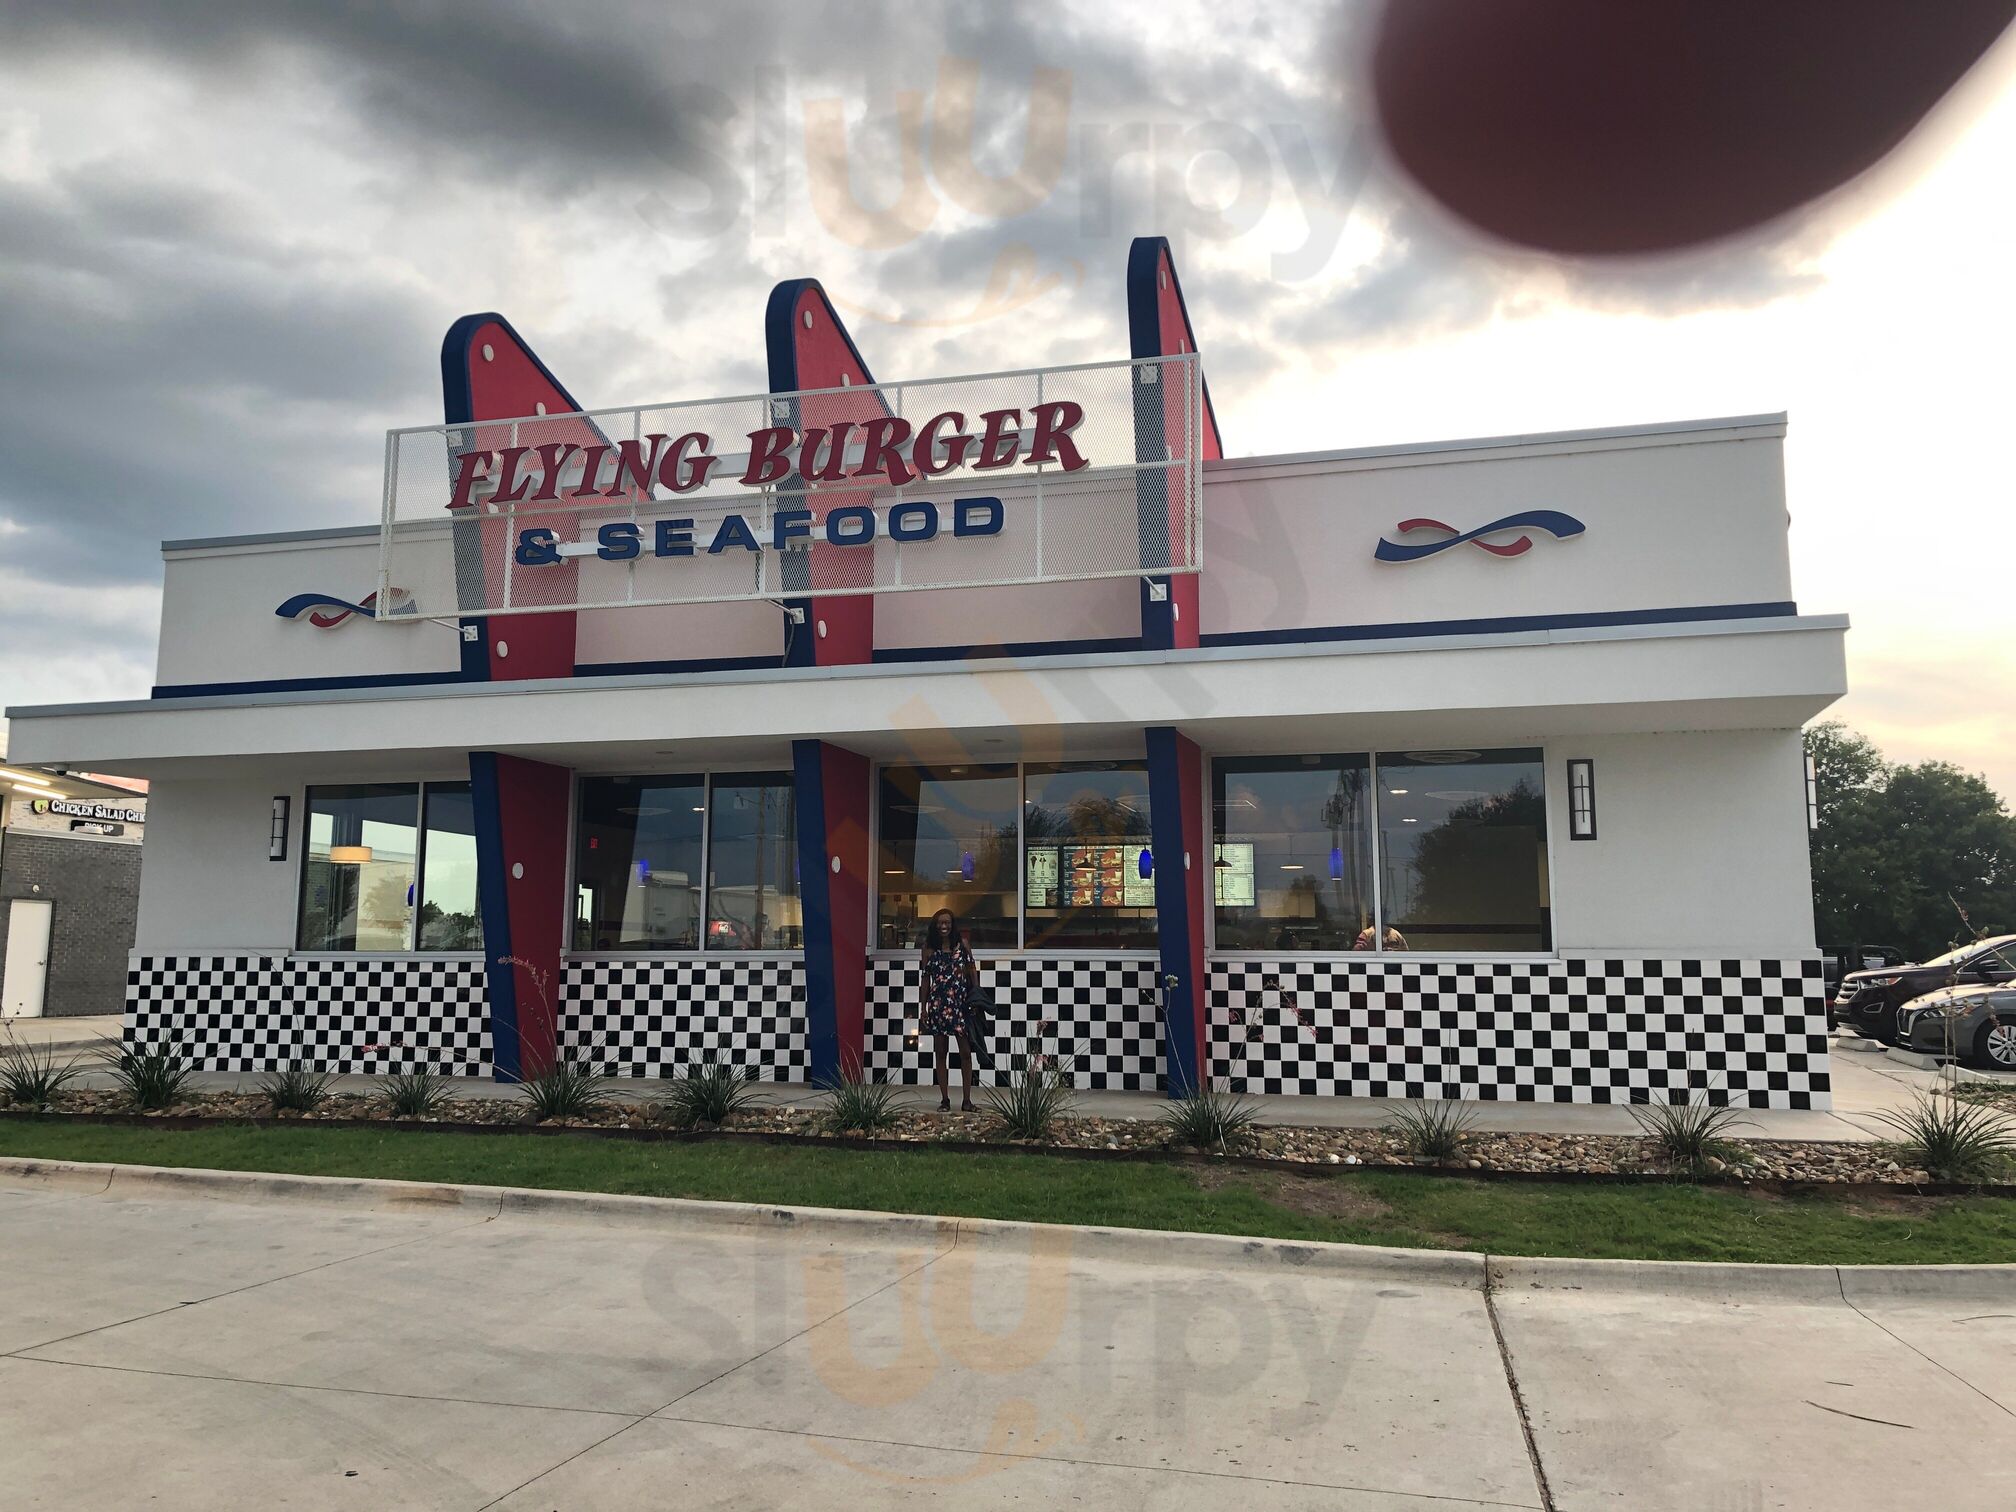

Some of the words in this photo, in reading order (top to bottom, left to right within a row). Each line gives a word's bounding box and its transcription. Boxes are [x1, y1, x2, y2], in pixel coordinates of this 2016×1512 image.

[445, 432, 720, 510] FLYING
[738, 401, 1090, 487] BURGER
[515, 528, 564, 566] &
[597, 497, 1005, 561] SEAFOOD
[51, 799, 94, 816] CHICKEN
[95, 805, 125, 820] SALAD
